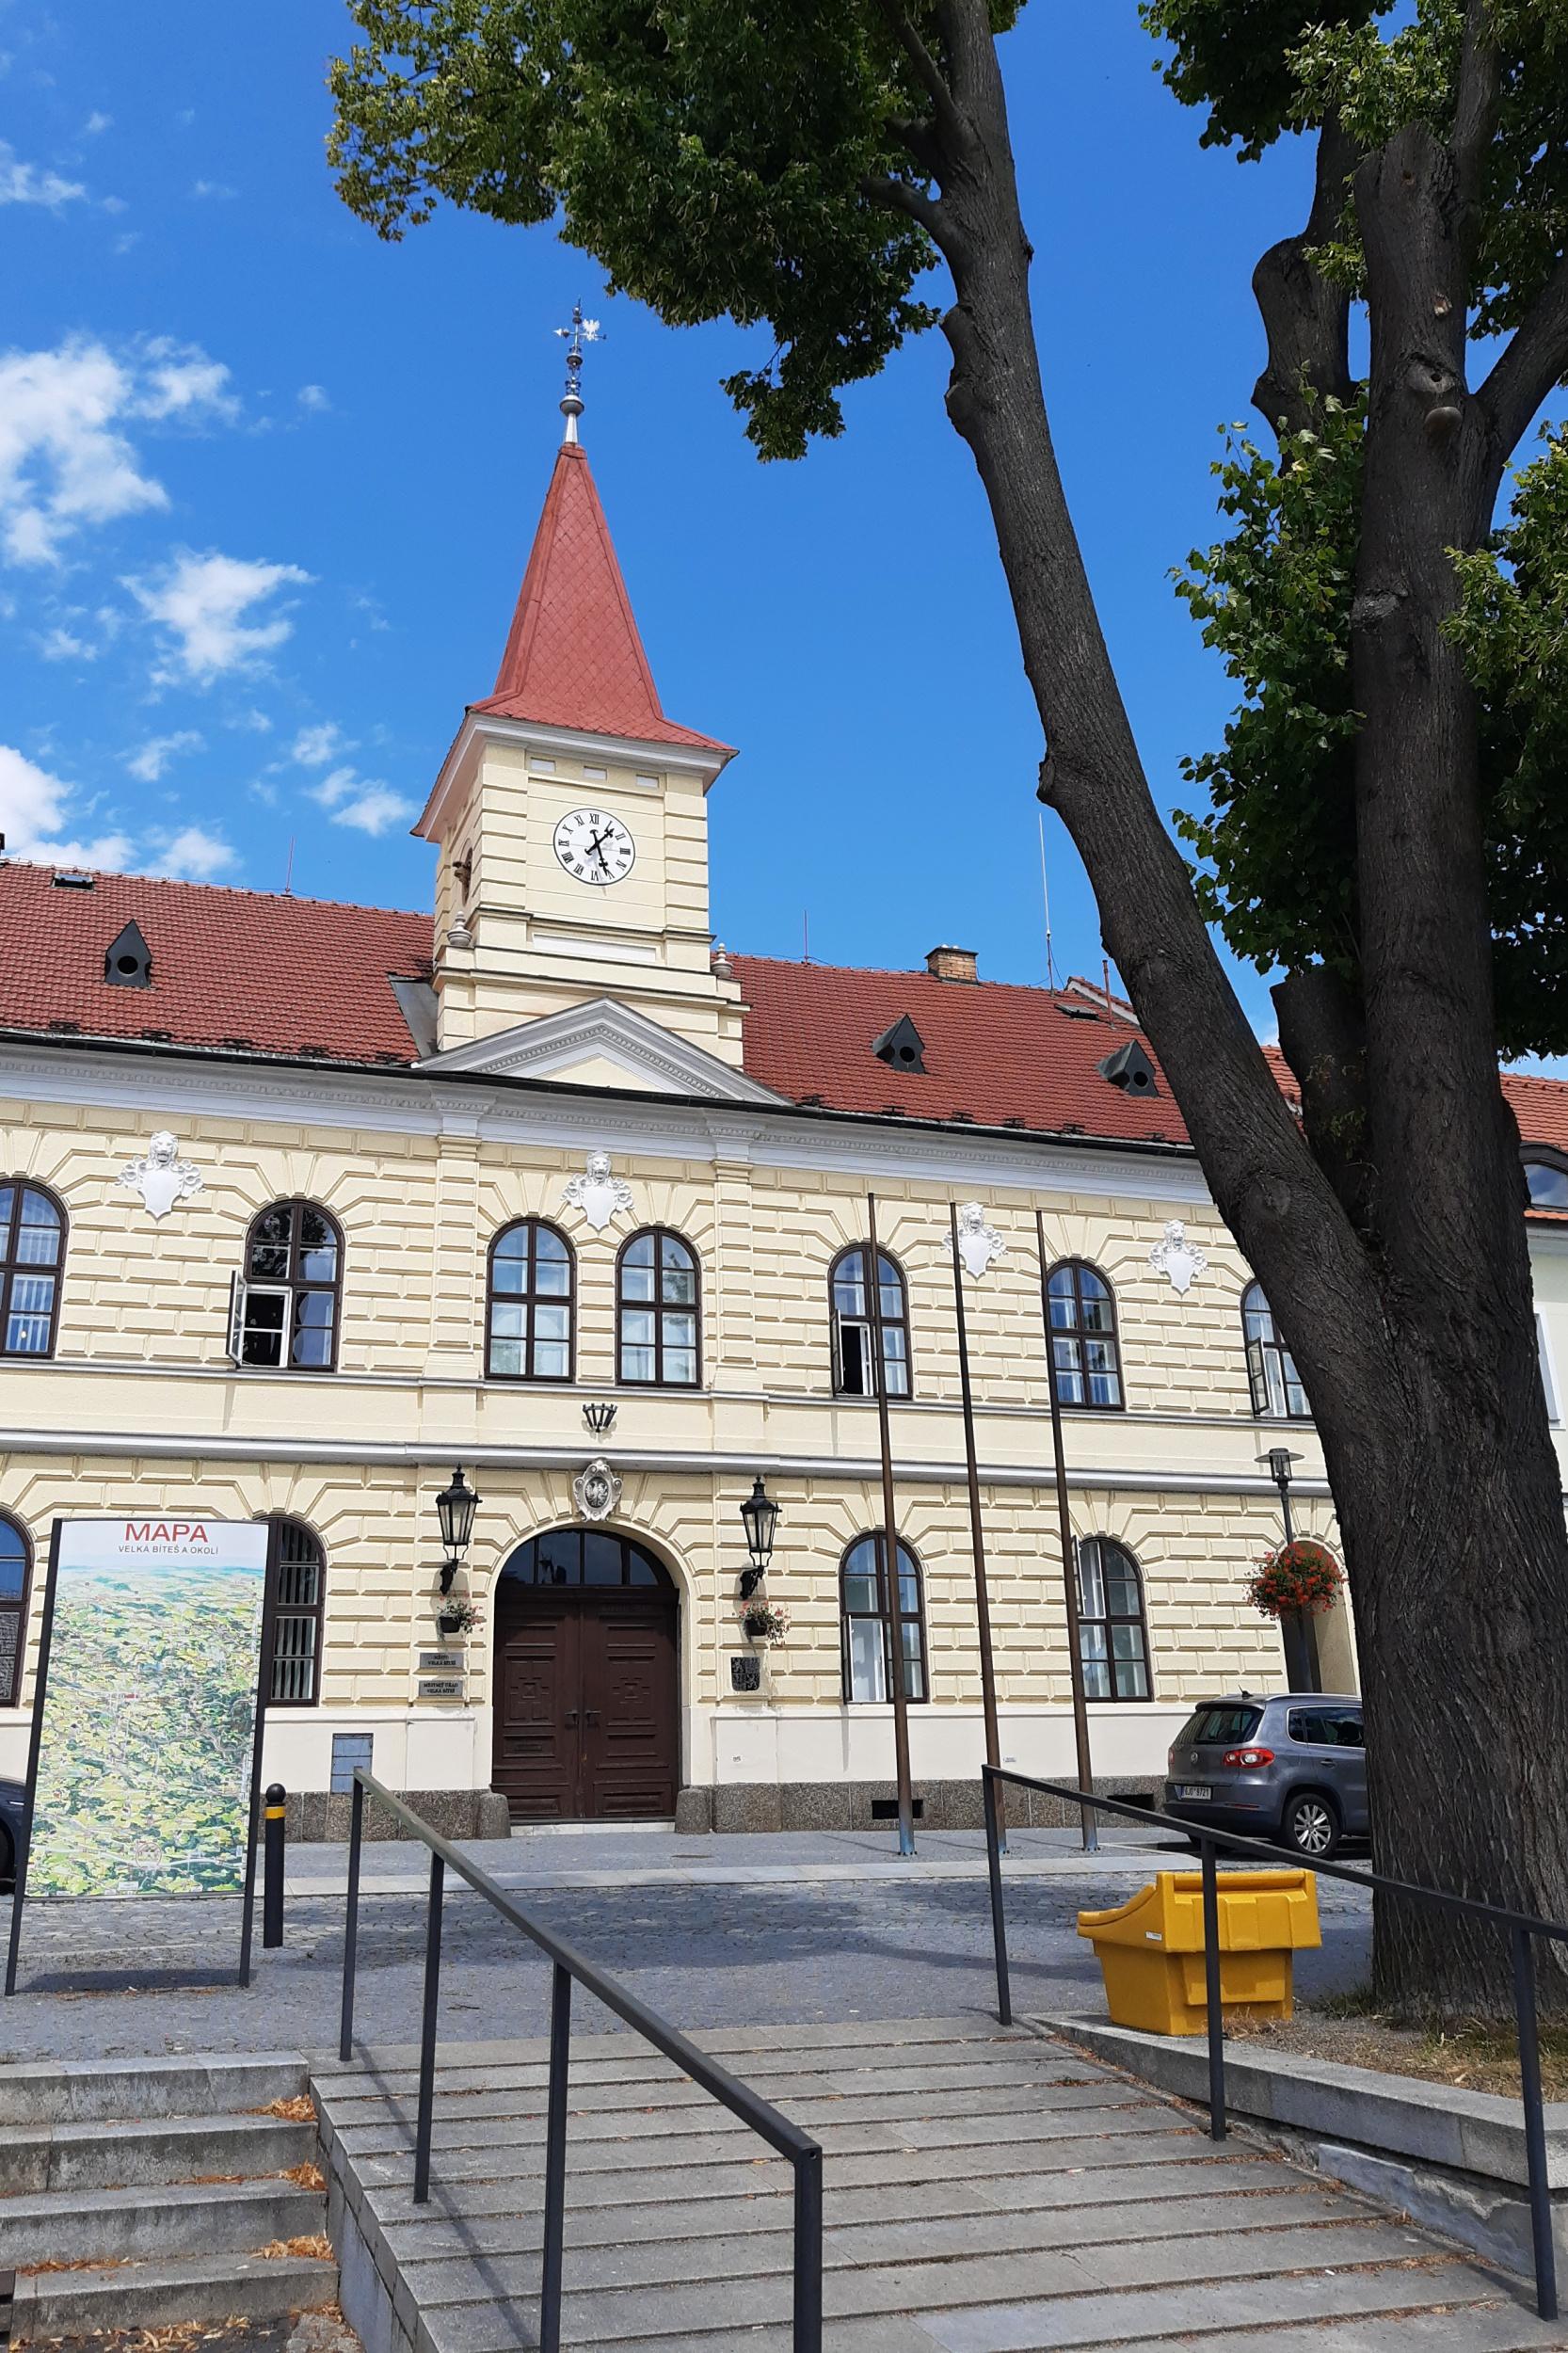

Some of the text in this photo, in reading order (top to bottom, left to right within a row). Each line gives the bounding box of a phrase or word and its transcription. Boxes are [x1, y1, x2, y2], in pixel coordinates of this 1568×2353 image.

[574, 815, 584, 826] XI
[589, 813, 600, 824] XII
[562, 824, 573, 835] X
[125, 1523, 208, 1543] MAPA
